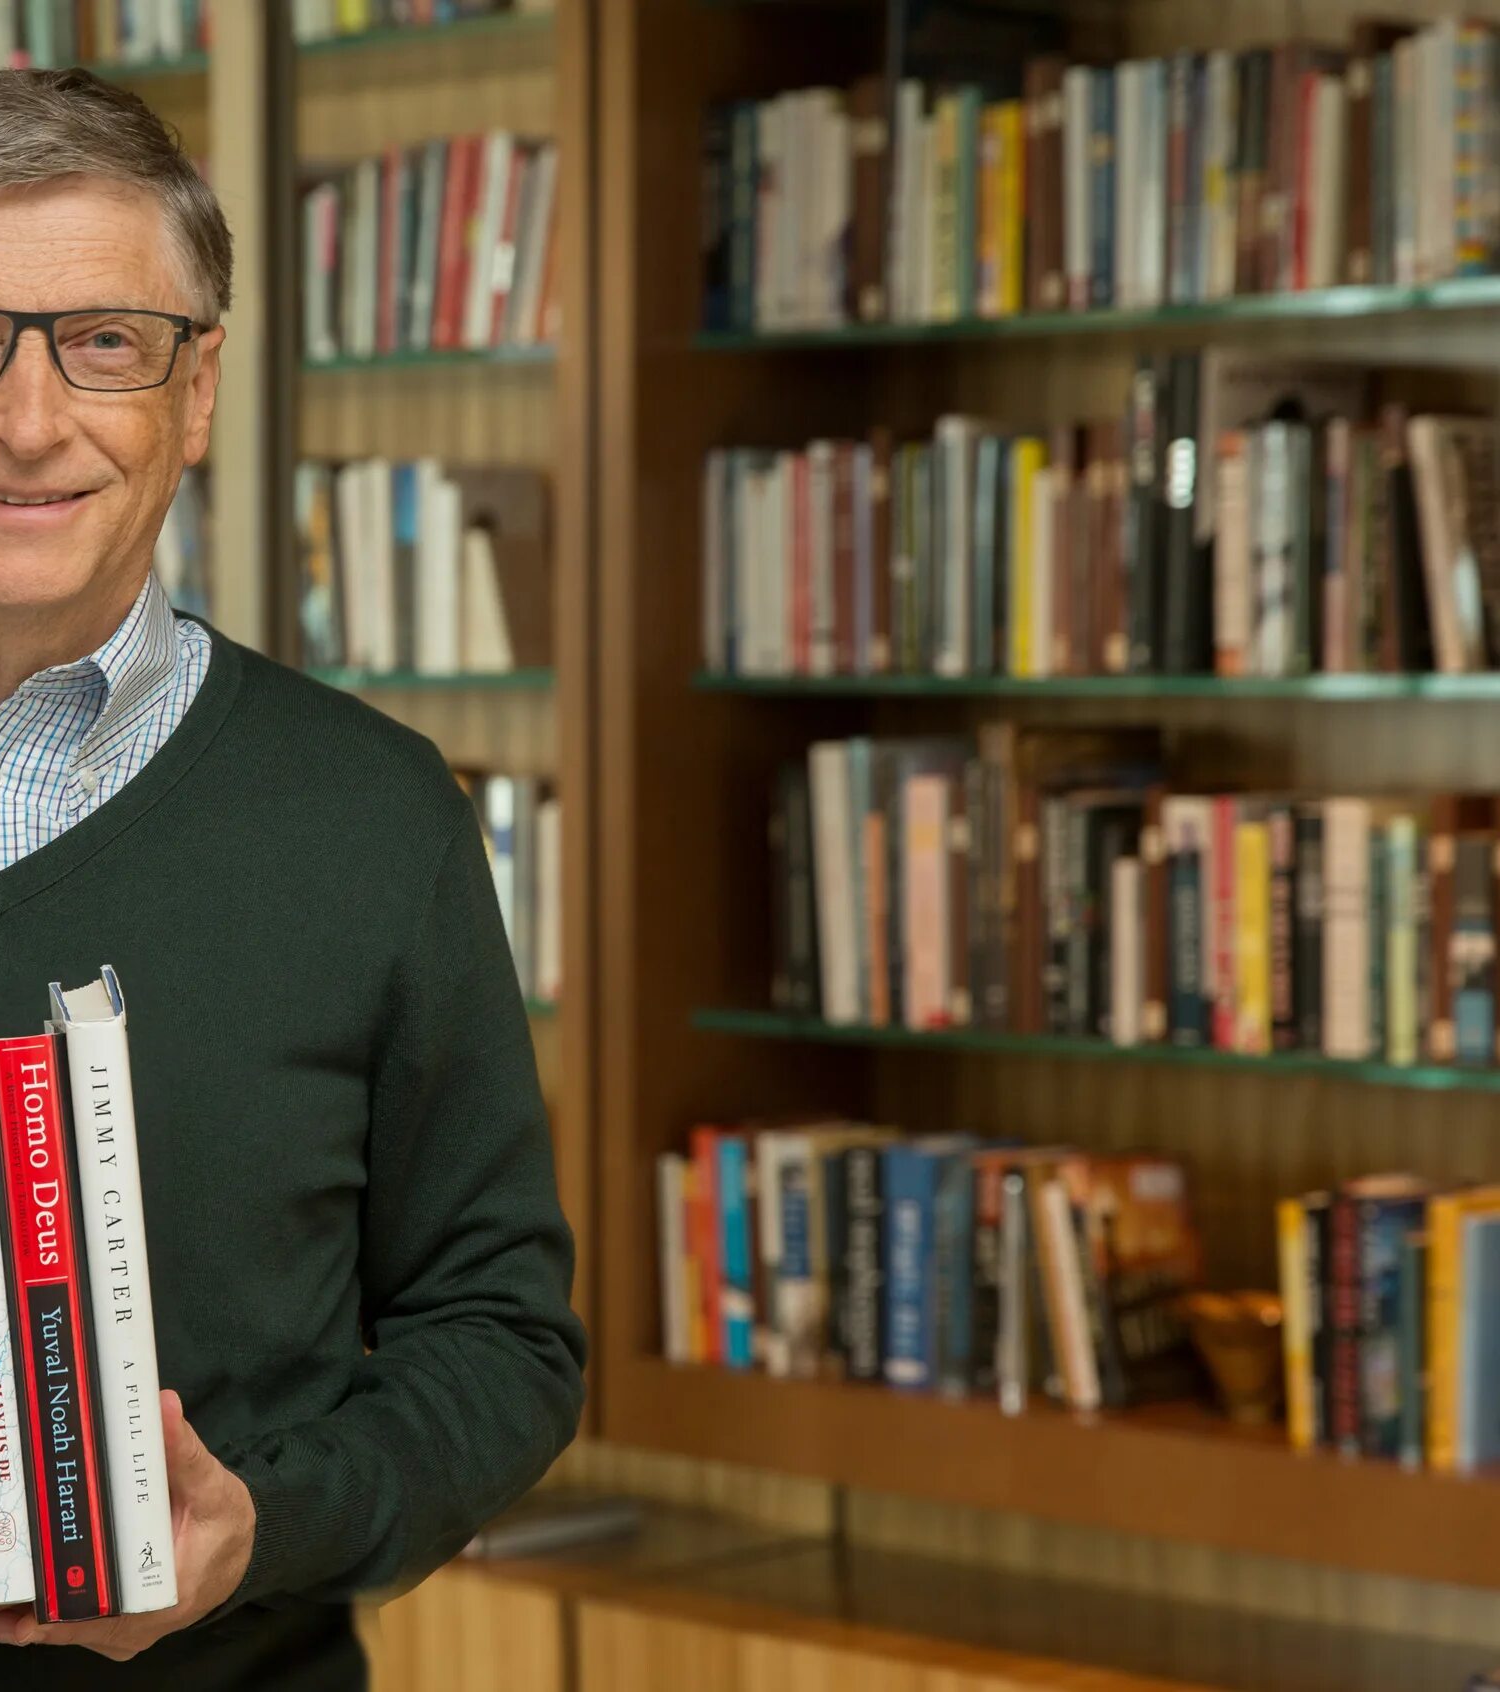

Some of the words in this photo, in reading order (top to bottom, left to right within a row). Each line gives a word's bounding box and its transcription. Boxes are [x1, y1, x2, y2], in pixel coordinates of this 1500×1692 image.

[20, 1060, 49, 1168] Homo
[90, 1065, 117, 1167] JIMMY
[32, 1178, 60, 1266] Deus
[103, 1190, 133, 1324] CARTER
[41, 1305, 69, 1377] Yuval
[122, 1360, 135, 1371] A
[48, 1383, 76, 1454] Noah
[126, 1384, 143, 1440] FULL
[56, 1459, 84, 1543] Harari
[133, 1452, 150, 1504] LIFE
